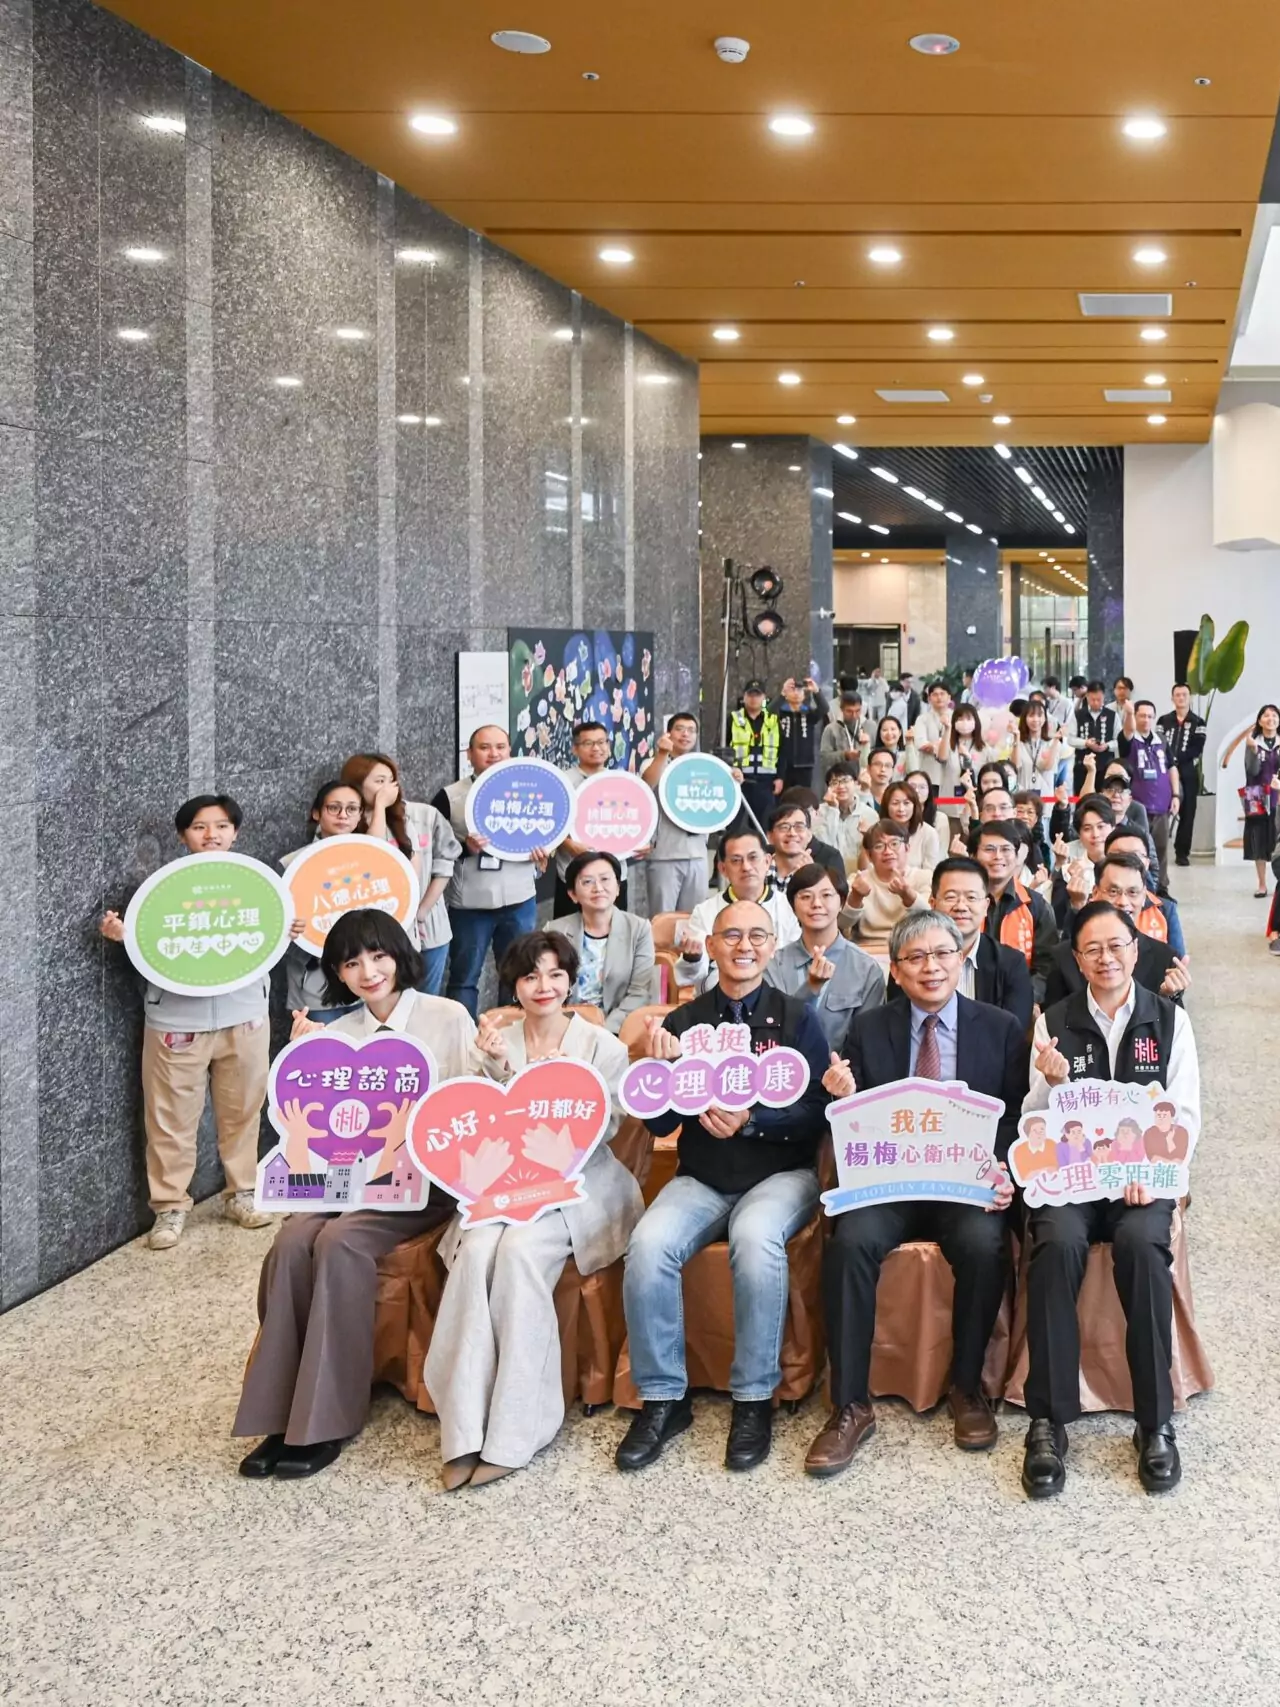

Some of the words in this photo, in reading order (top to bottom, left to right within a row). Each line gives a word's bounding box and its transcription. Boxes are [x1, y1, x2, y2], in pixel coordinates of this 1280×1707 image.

[490, 799, 554, 817] 楊梅心理
[162, 907, 260, 933] 平鎮心理
[163, 937, 260, 956] 衛生中心
[687, 1027, 746, 1056] 我挺
[286, 1063, 420, 1094] 心理諮商
[630, 1060, 796, 1101] 心理健康
[1055, 1085, 1141, 1114] 楊梅有心
[890, 1107, 944, 1135] 我在
[844, 1141, 989, 1168] 楊梅心衛中心
[1030, 1161, 1180, 1198] 心理零距離
